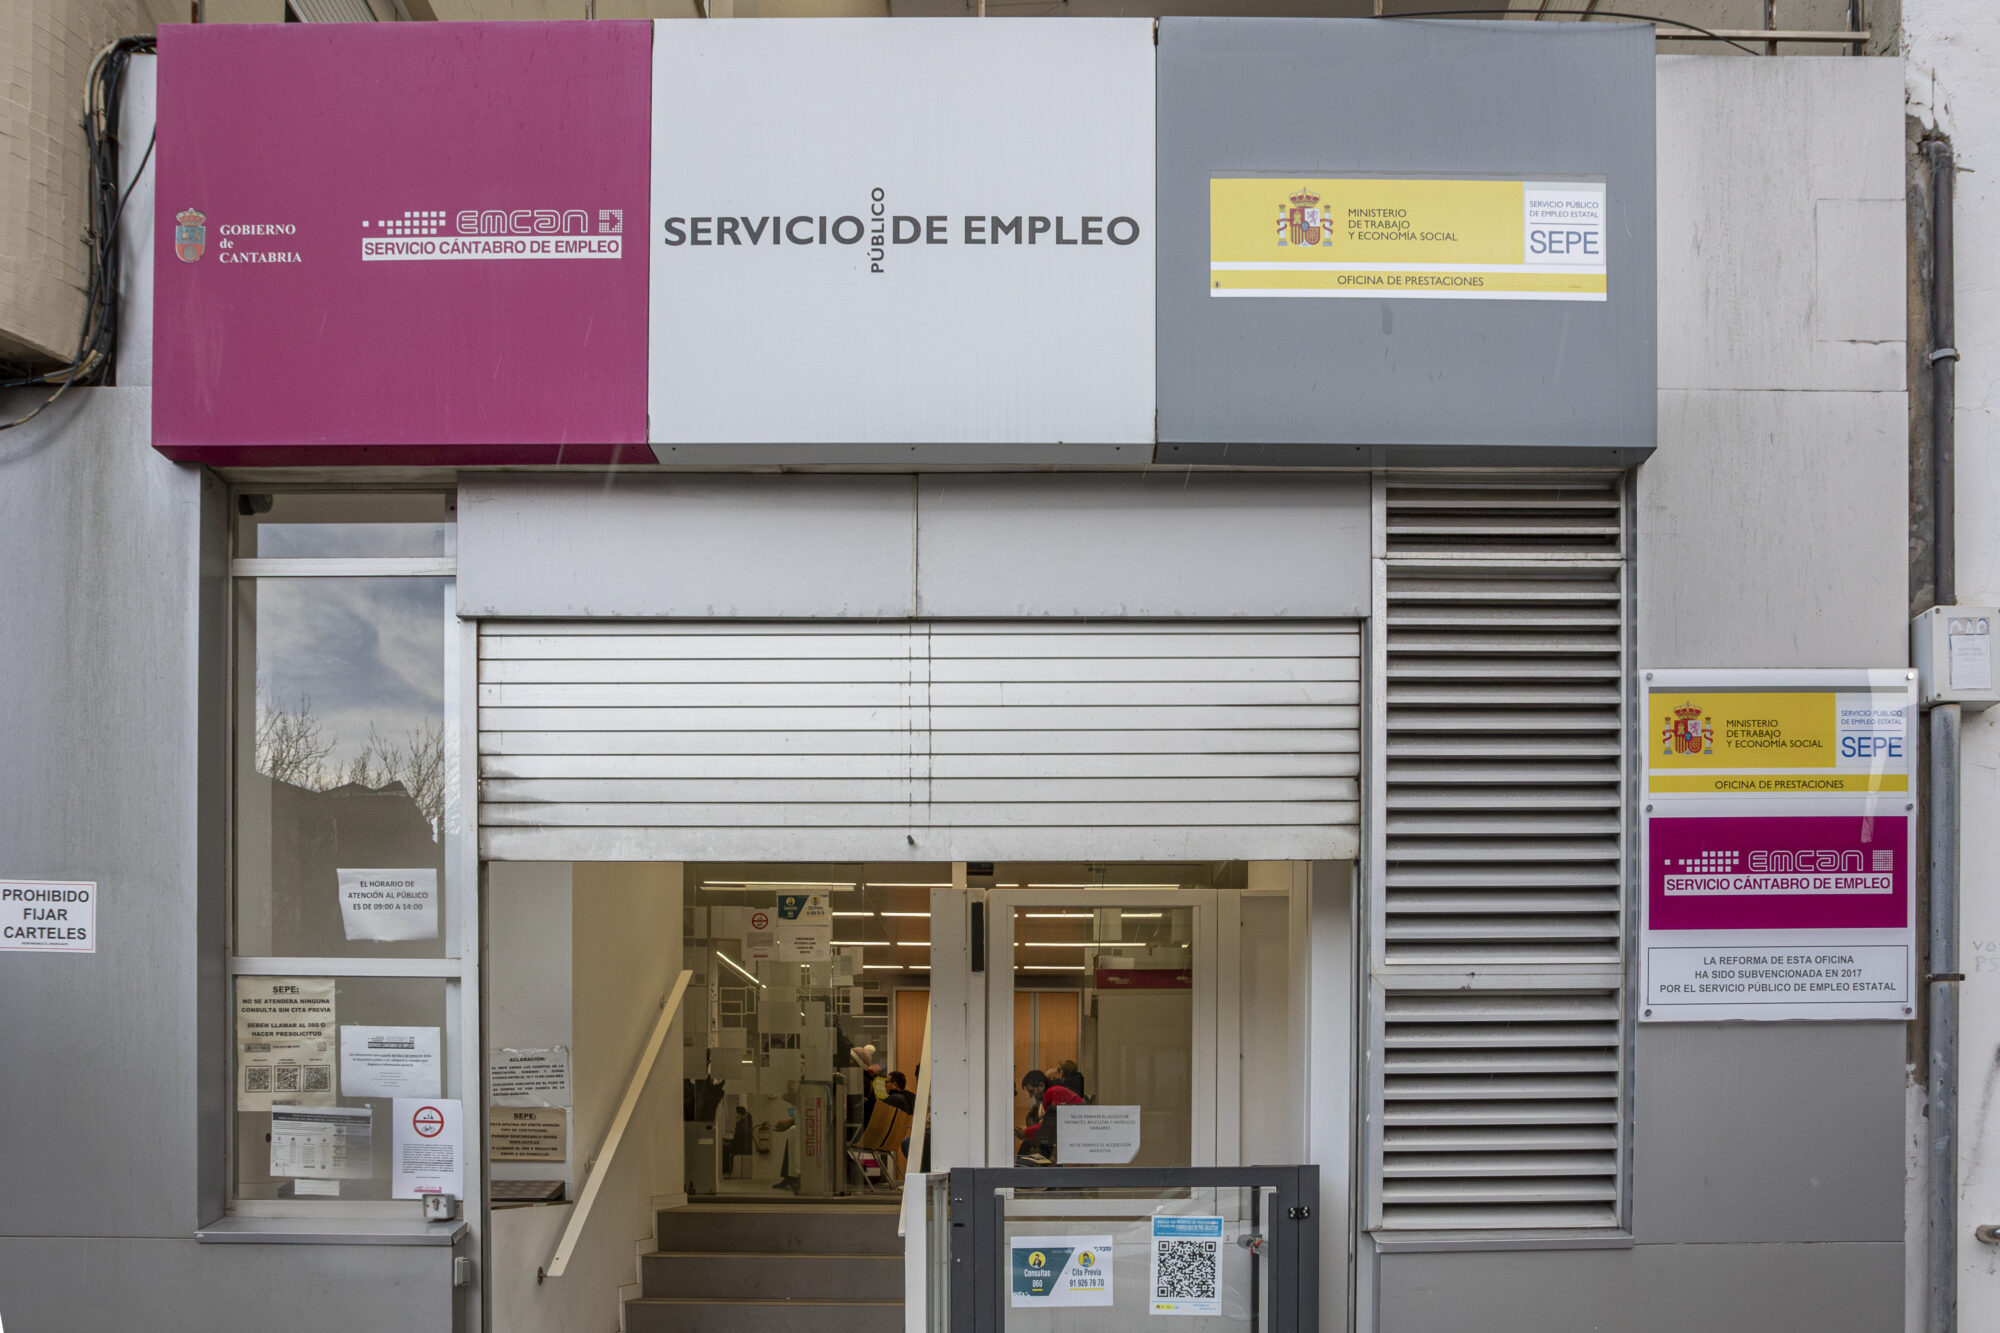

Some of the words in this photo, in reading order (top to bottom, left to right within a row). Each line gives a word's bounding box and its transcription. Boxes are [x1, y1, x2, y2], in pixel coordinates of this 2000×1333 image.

[1530, 201, 1564, 209] SERVICIO
[1566, 201, 1599, 209] PÚBLICO
[1348, 209, 1407, 218] MINISTERIO
[220, 224, 296, 235] GOBIERNO
[664, 215, 865, 246] SERVICIO
[892, 215, 948, 245] DE
[964, 215, 1140, 246] EMPLEO
[867, 187, 885, 273] PÚBLICO
[1348, 220, 1362, 229] DE
[1364, 220, 1410, 231] TRABAJO
[1348, 232, 1355, 240] Y
[1358, 230, 1417, 240] ECONOMÍA
[1420, 232, 1458, 241] SOCIAL
[219, 238, 234, 248] de
[364, 241, 436, 255] SERVICIO
[439, 238, 526, 254] CÁNTABRO
[530, 241, 550, 253] DE
[555, 240, 619, 253] EMPLEO
[1530, 230, 1599, 254] SEPE
[219, 252, 302, 263] CANTABRIA
[1337, 275, 1384, 285] OFICINA
[1387, 276, 1401, 285] DE
[1405, 276, 1484, 287] PRESTACIONES
[1726, 719, 1778, 727] MINISTERIO
[1726, 730, 1739, 738] DE
[1740, 730, 1781, 739] TRABAJO
[1726, 740, 1732, 748] Y
[1735, 738, 1787, 748] ECONOMÍA
[1790, 740, 1823, 748] SOCIAL
[1841, 736, 1902, 757] SEPE
[1714, 780, 1756, 789] OFICINA
[1759, 780, 1772, 789] DE
[1774, 780, 1844, 789] PRESTACIONES
[1666, 878, 1730, 891] SERVICIO
[1733, 875, 1810, 890] CÁNTABRO
[1813, 878, 1831, 889] DE
[1835, 877, 1890, 889] EMPLEO
[2, 889, 89, 903] PROHIBIDO
[348, 890, 384, 899] ATENCIÓN
[386, 890, 395, 899] AL
[396, 890, 428, 899] PÚBLICO
[23, 908, 68, 921] FIJAR
[4, 926, 87, 940] CARTELES
[1703, 956, 1716, 965] LA
[1719, 956, 1768, 965] REFORMA
[1770, 956, 1784, 965] DE
[1786, 956, 1812, 964] ESTA
[1814, 955, 1854, 964] OFICINA
[1695, 970, 1709, 979] HA
[1711, 970, 1735, 979] SIDO
[1737, 969, 1823, 979] SUBVENCIONADA
[1825, 969, 1839, 978] EN
[1841, 969, 1862, 978] 2017
[272, 985, 299, 993] SEPE:
[1660, 984, 1681, 993] POR
[1684, 984, 1697, 993] EL
[1698, 984, 1745, 993] SERVICIO
[1747, 981, 1791, 993] PÚBLICO
[1793, 983, 1807, 992] DE
[1809, 983, 1850, 992] EMPLEO
[1852, 982, 1896, 991] ESTATAL
[1024, 1269, 1051, 1277] Consultas
[1071, 1268, 1083, 1277] Cita
[1084, 1268, 1102, 1277] Previa
[1032, 1280, 1043, 1288] 060
